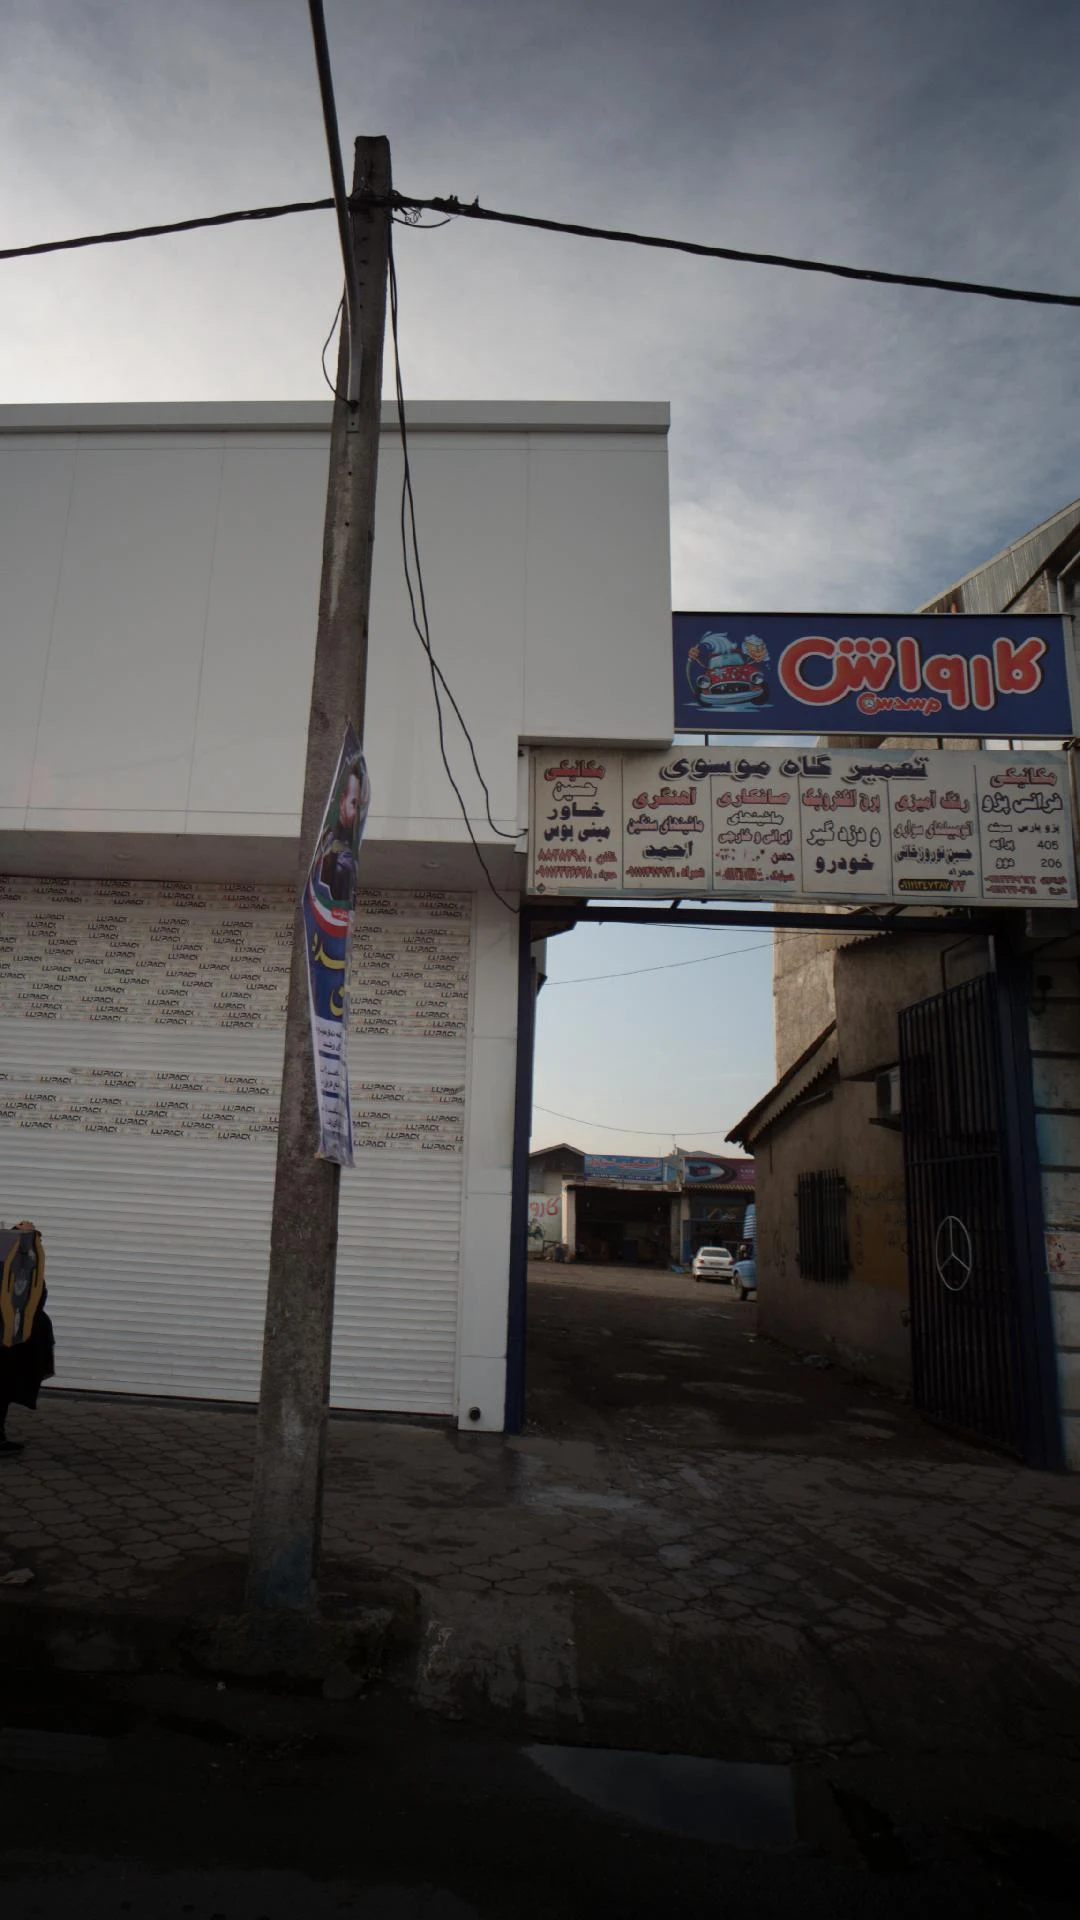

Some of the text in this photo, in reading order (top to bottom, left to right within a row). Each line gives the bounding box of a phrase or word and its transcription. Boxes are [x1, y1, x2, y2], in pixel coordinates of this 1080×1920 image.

[778, 636, 1046, 711] کارواش
[659, 755, 928, 784] تعمیر گاه موسوی
[716, 788, 790, 808] صافکاری
[859, 793, 881, 813] برق
[940, 790, 970, 813] رنگ
[982, 791, 1011, 815] پژو
[547, 802, 605, 820] خاور
[544, 822, 611, 842] مینی بوس
[870, 827, 881, 847] و
[643, 841, 694, 861] احمد
[1037, 840, 1059, 850] 405
[814, 853, 874, 874] خودرو
[1041, 858, 1062, 868] 206
